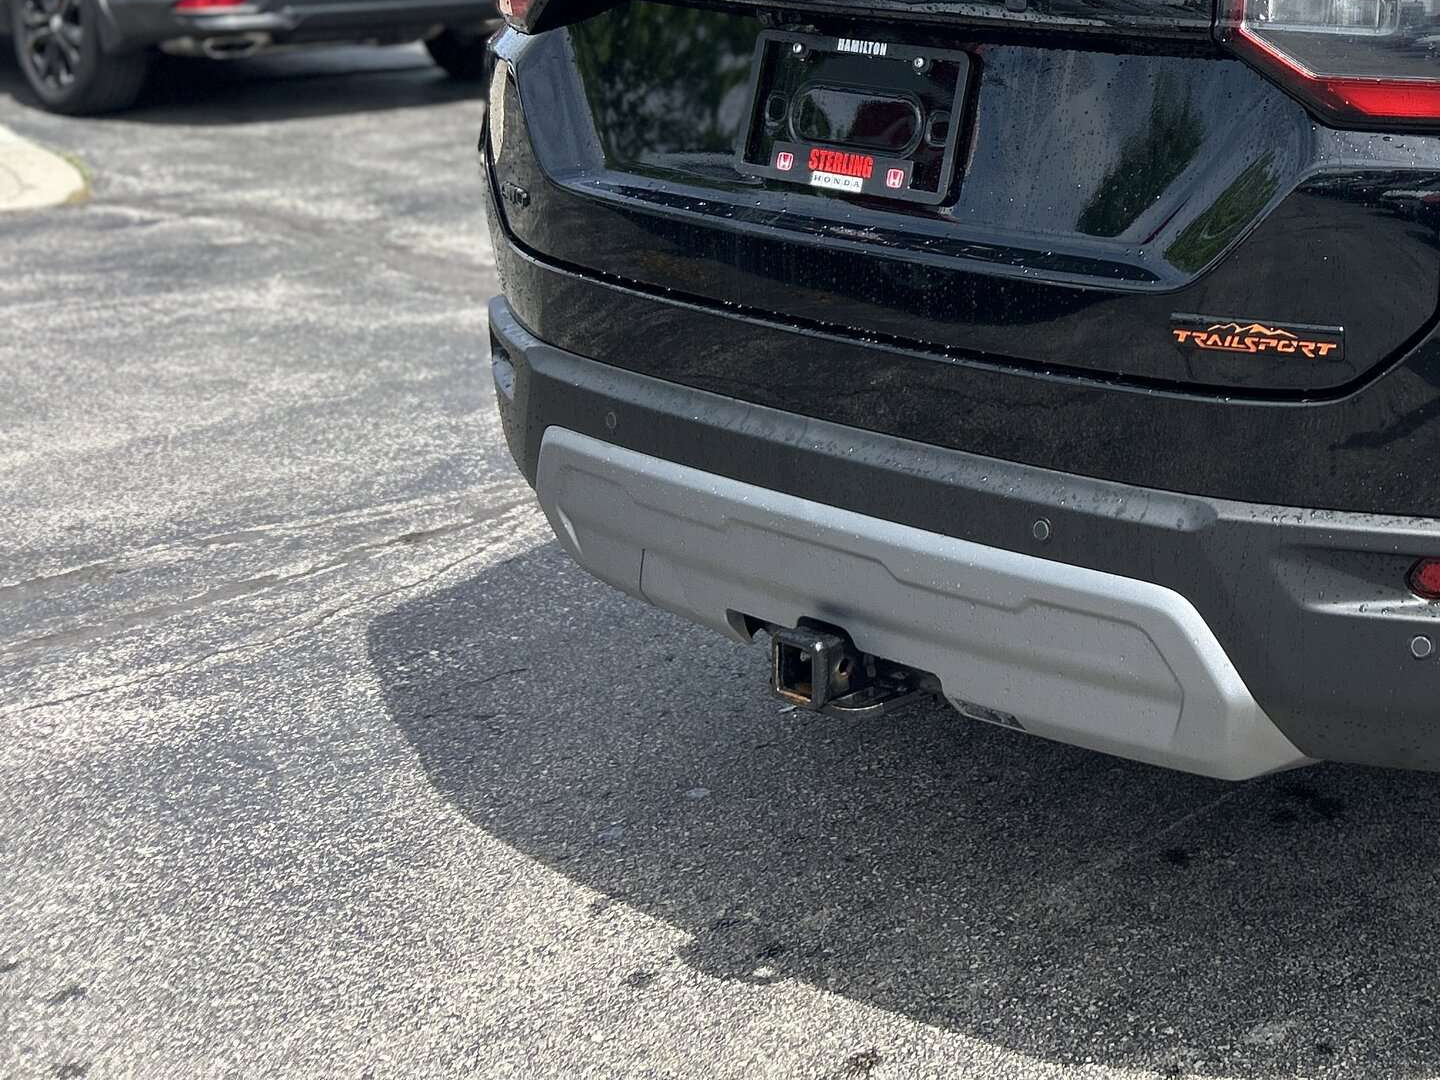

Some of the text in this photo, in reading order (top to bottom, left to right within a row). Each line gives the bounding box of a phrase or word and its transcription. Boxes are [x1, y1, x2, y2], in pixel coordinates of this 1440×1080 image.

[837, 37, 888, 56] HAMILTON
[809, 148, 873, 179] STERLING
[813, 174, 861, 188] HONDA
[1172, 328, 1337, 358] TRAILSPORT
